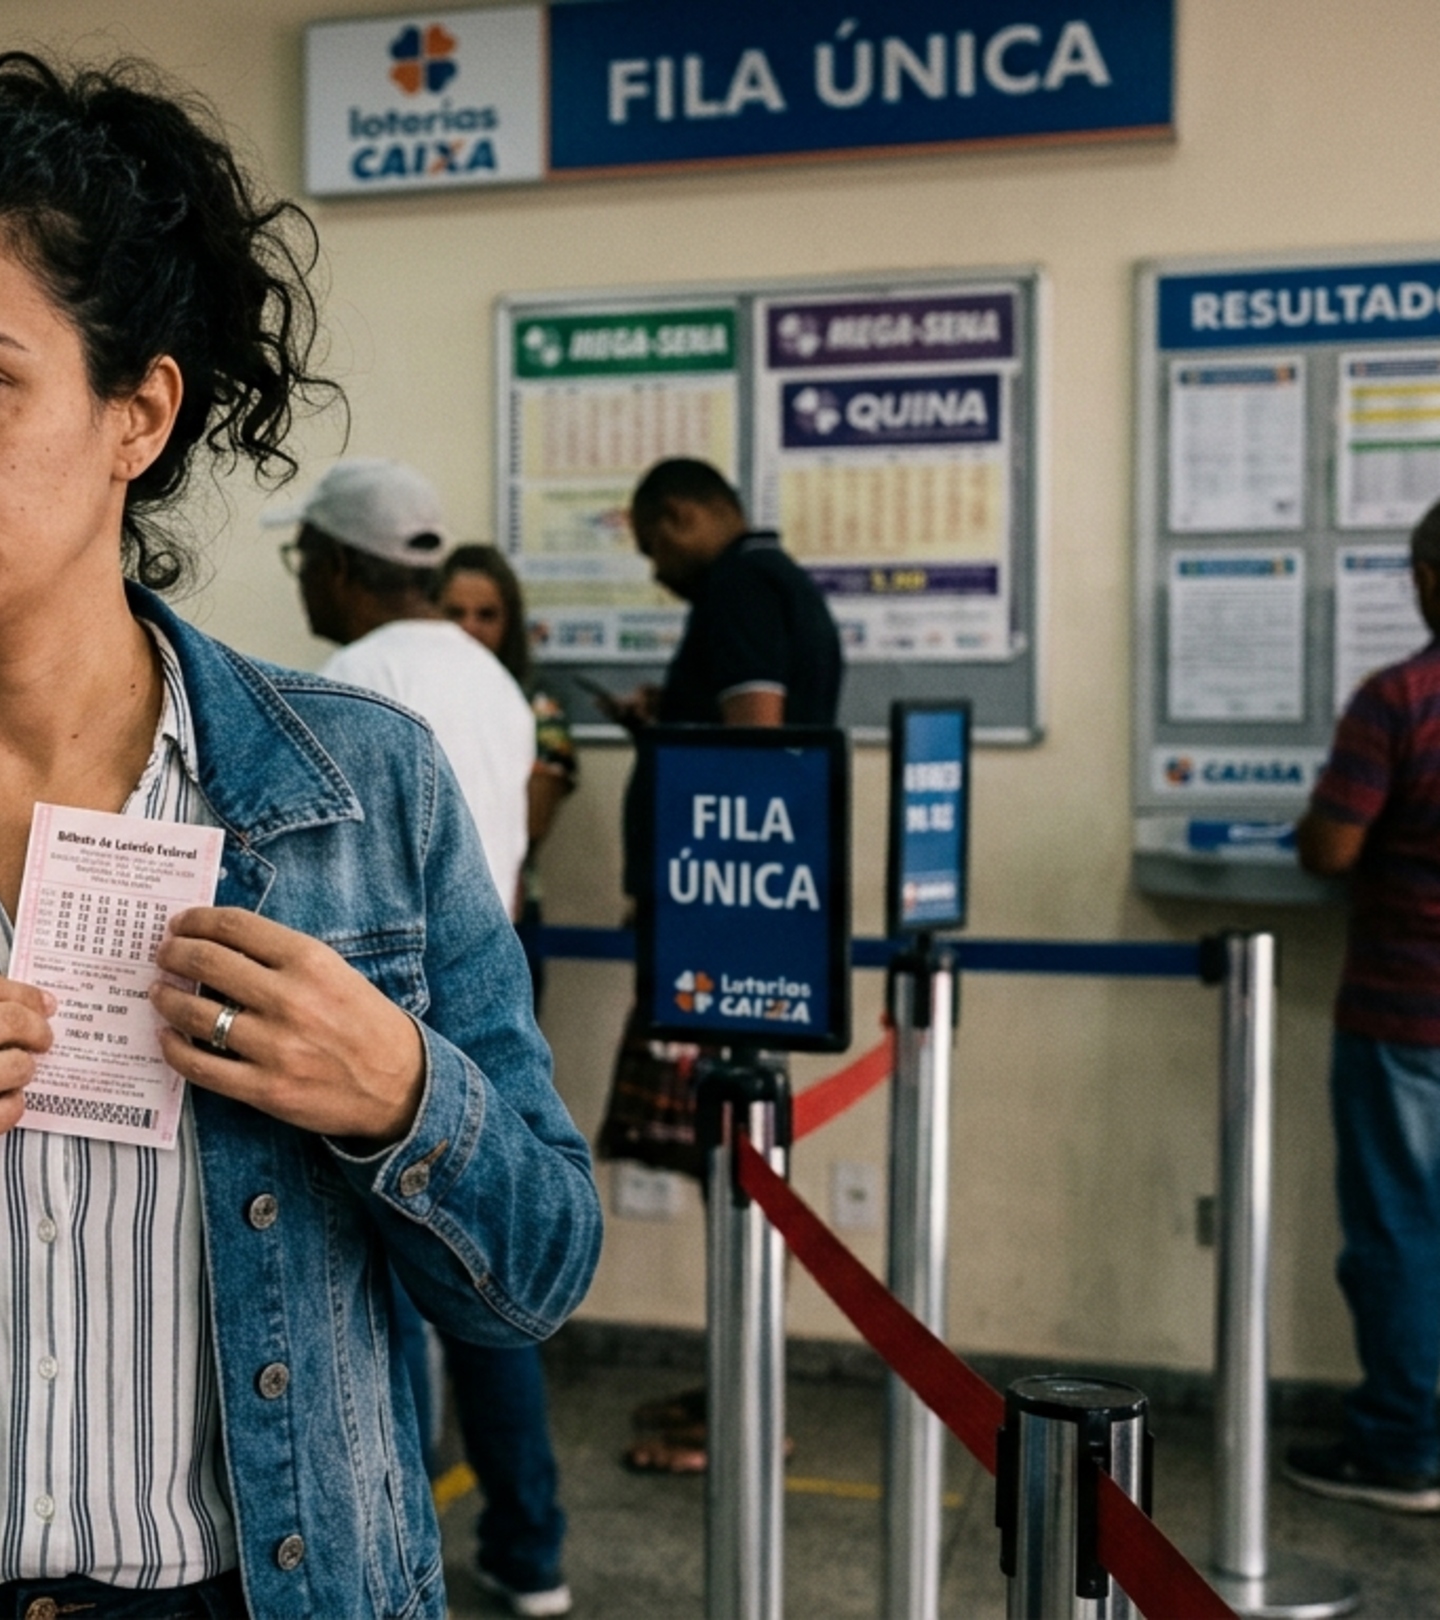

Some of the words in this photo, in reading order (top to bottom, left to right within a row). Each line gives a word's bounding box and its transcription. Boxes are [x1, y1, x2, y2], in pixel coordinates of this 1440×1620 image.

[607, 49, 787, 125] FILA
[815, 20, 1111, 110] ÚNICA
[348, 99, 498, 140] loterias
[350, 138, 498, 181] CAIXA
[1191, 282, 1440, 332] RESULTAD
[569, 323, 728, 362] MEGA-SENA
[825, 310, 1000, 352] MEGA-SENA
[846, 389, 988, 431] QUINA
[692, 794, 795, 843] FILA
[668, 848, 820, 911] ÚNICA
